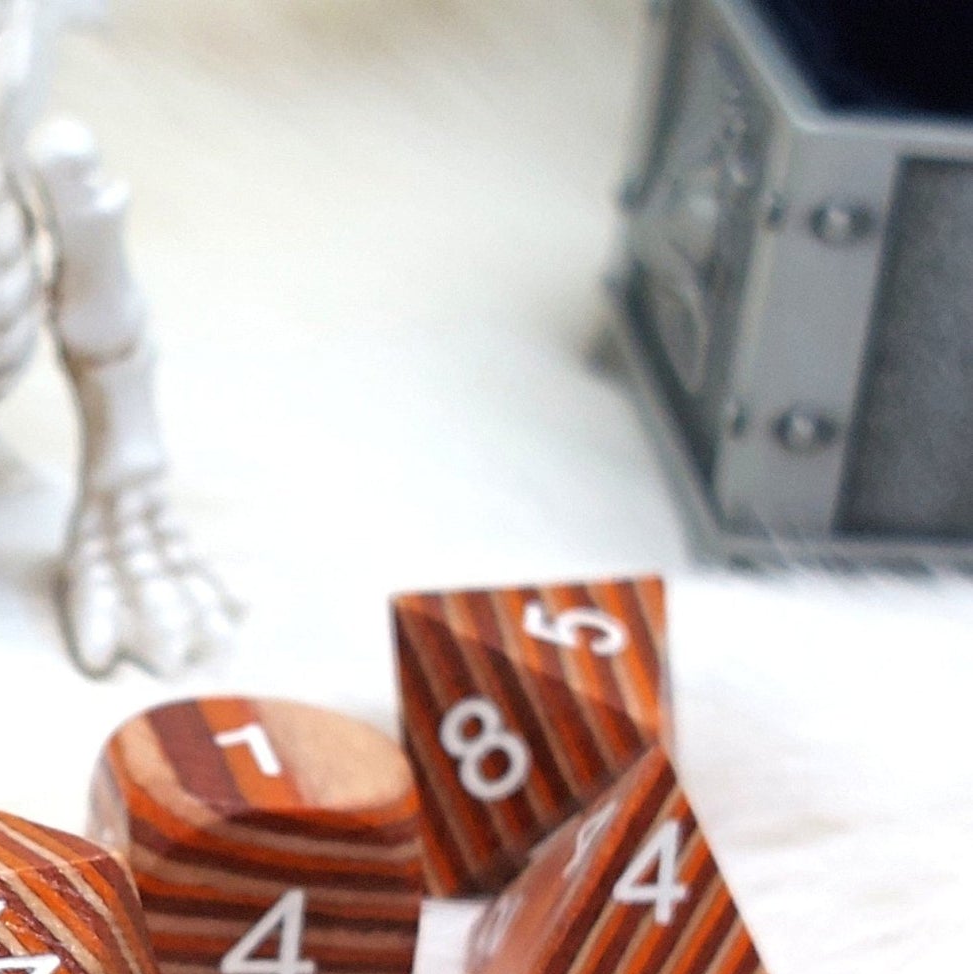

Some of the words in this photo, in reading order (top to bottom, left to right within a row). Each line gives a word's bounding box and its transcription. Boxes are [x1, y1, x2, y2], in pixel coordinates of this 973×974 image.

[524, 602, 628, 656] 5
[439, 697, 528, 799] 8
[612, 820, 691, 924] 4
